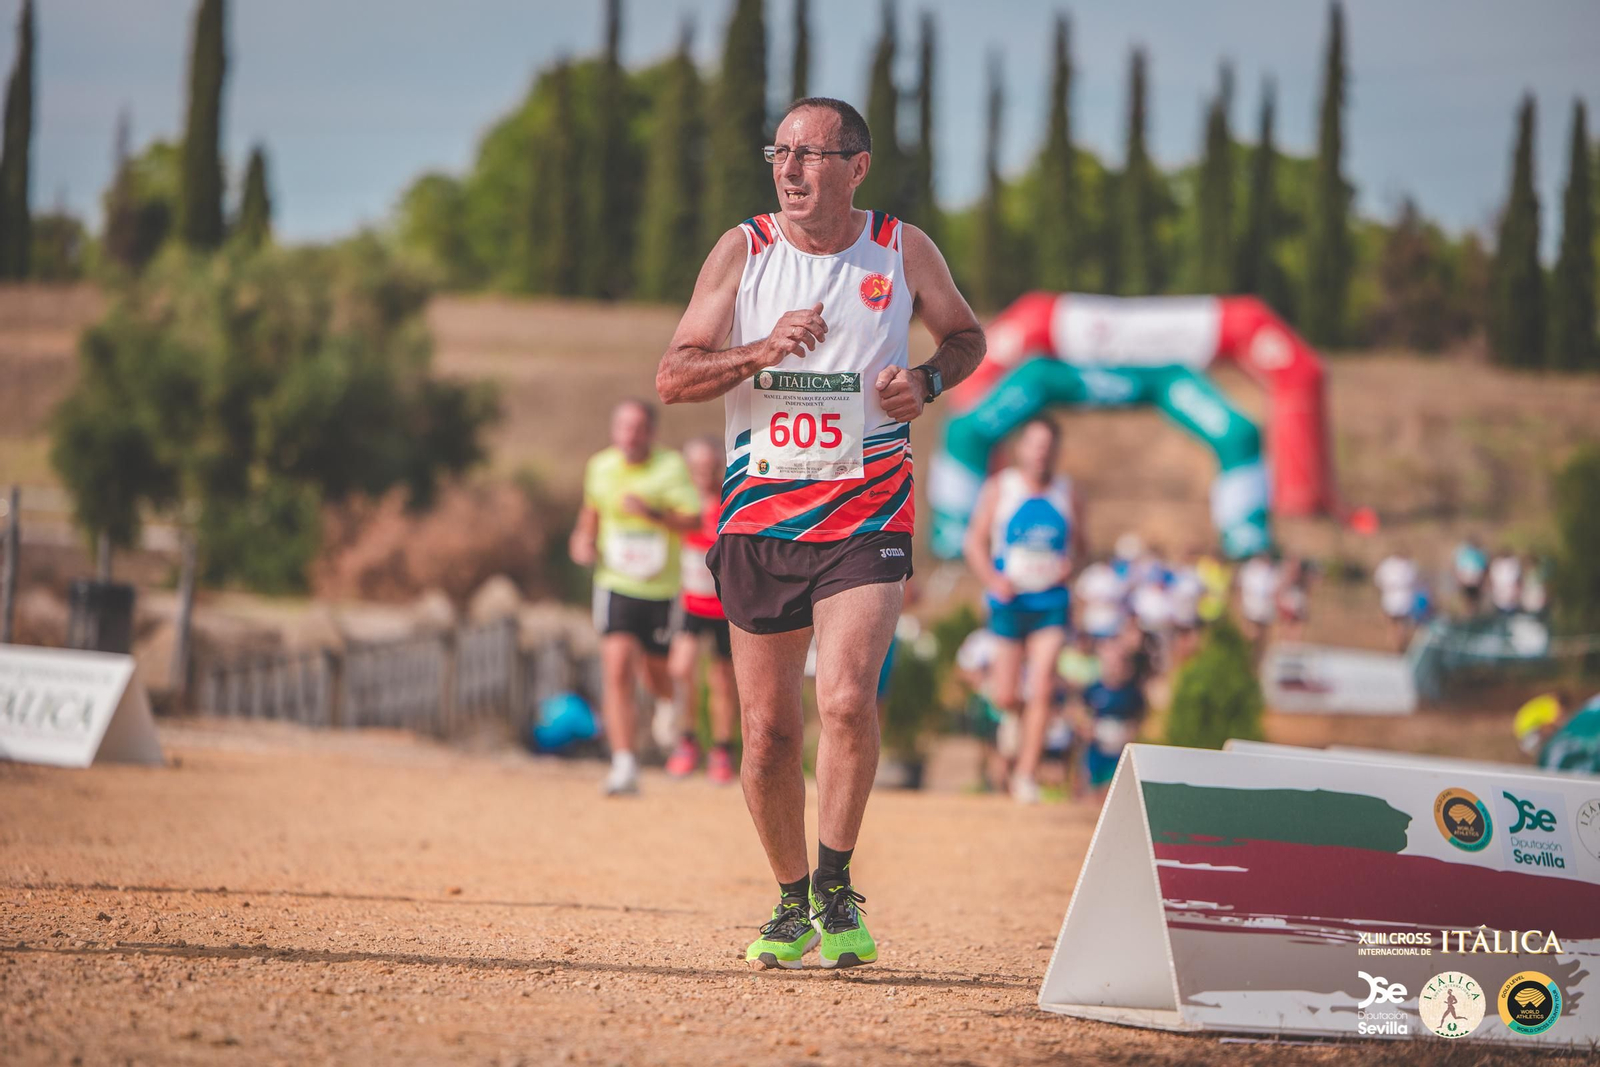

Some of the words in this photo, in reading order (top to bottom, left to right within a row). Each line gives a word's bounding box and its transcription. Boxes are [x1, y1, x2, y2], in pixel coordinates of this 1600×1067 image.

[778, 373, 832, 389] ITÁLICA
[769, 411, 843, 449] 605
[1510, 836, 1563, 852] Diputación
[1513, 849, 1566, 869] Sevilla
